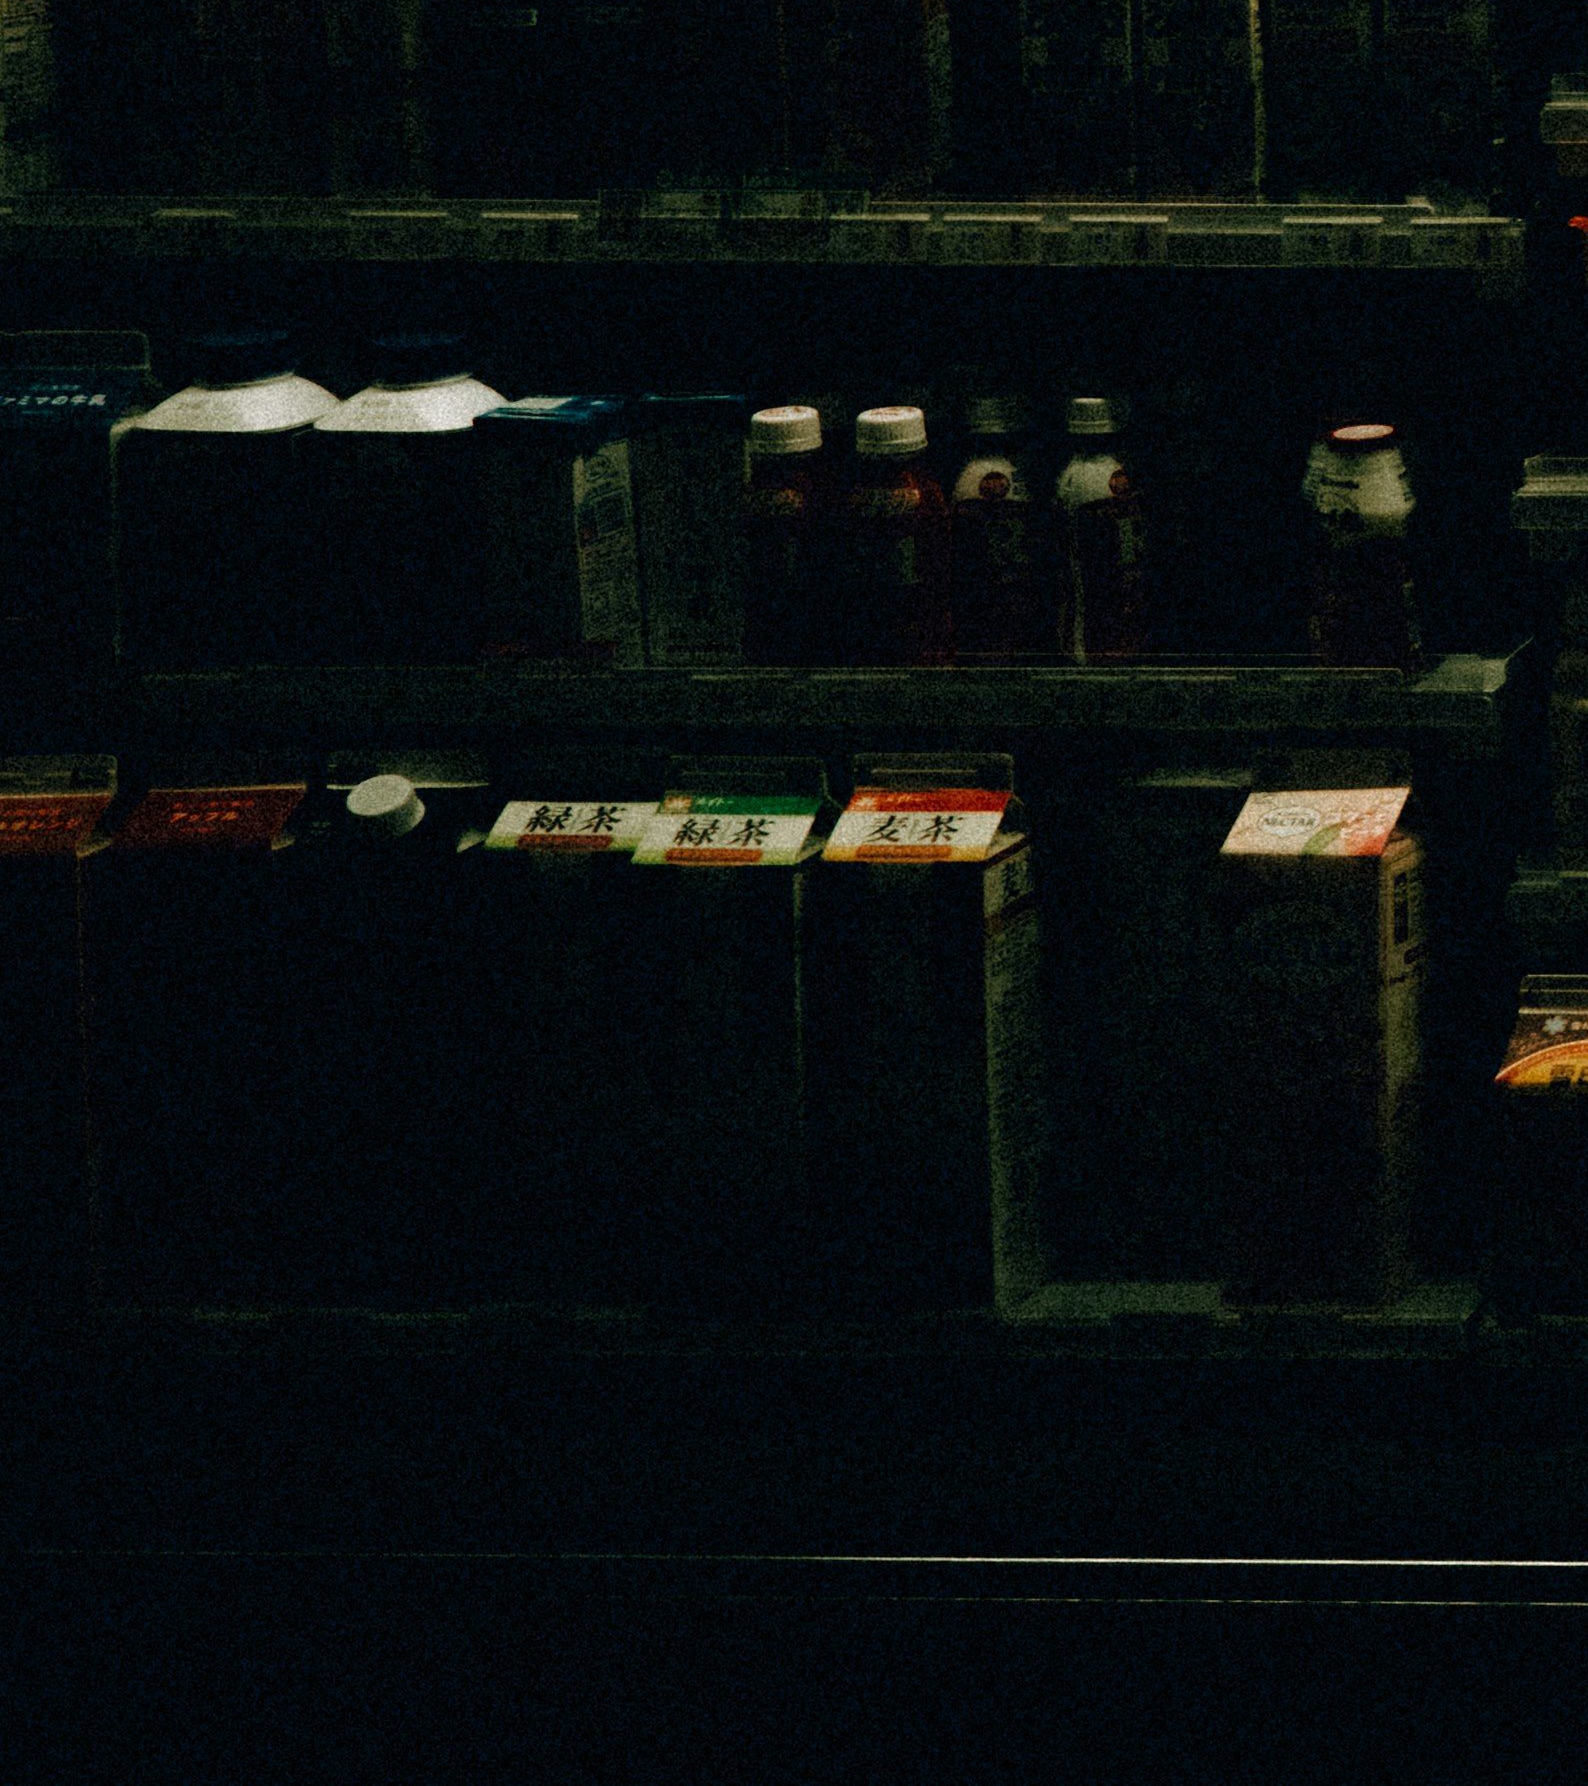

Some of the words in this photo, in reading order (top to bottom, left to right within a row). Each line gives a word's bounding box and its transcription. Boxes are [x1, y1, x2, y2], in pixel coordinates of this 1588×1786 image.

[525, 806, 628, 834] 緑茶
[672, 818, 778, 847] 緑茶
[866, 814, 962, 844] 麦茶
